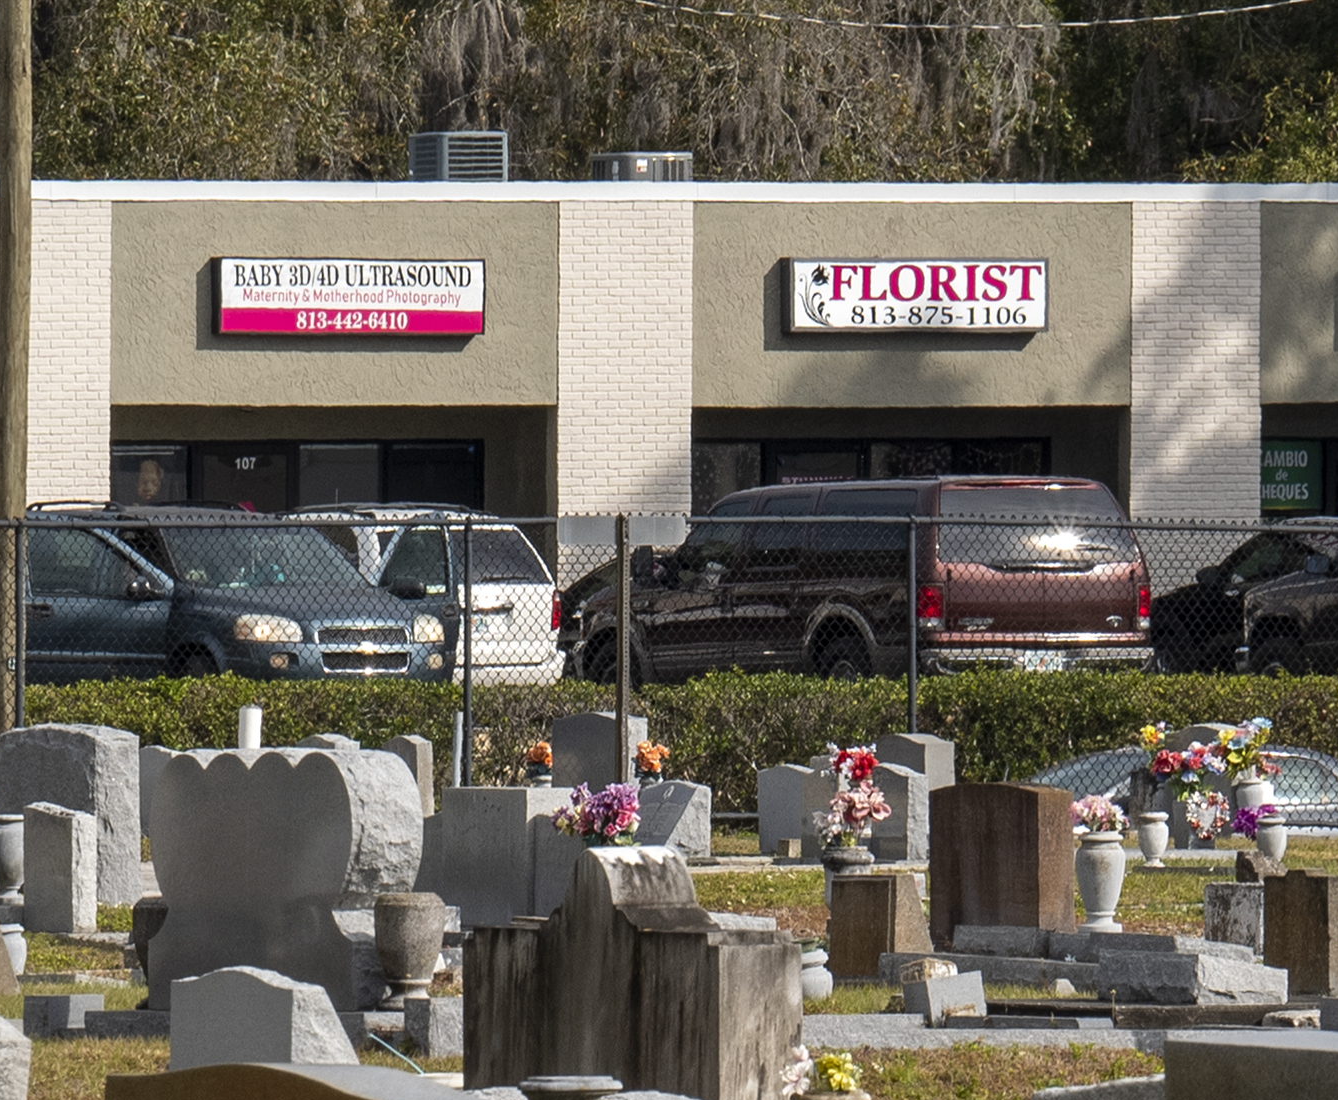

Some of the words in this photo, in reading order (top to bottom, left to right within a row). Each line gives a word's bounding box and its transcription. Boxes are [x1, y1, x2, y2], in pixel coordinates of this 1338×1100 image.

[234, 264, 283, 287] BABY
[289, 264, 338, 287] 3D/4D
[345, 264, 472, 288] ULTRASOUND
[829, 265, 1042, 301] FLORIST
[242, 289, 301, 305] Maternity
[302, 289, 311, 303] &
[313, 289, 384, 304] Motherhood
[387, 289, 462, 307] Photography
[296, 311, 408, 330] 813-442-6410
[851, 306, 1027, 325] 813-875-1106
[234, 457, 257, 470] 107
[1261, 450, 1309, 468] AMBIO
[1275, 468, 1289, 481] de
[1261, 483, 1310, 501] HEQUES
